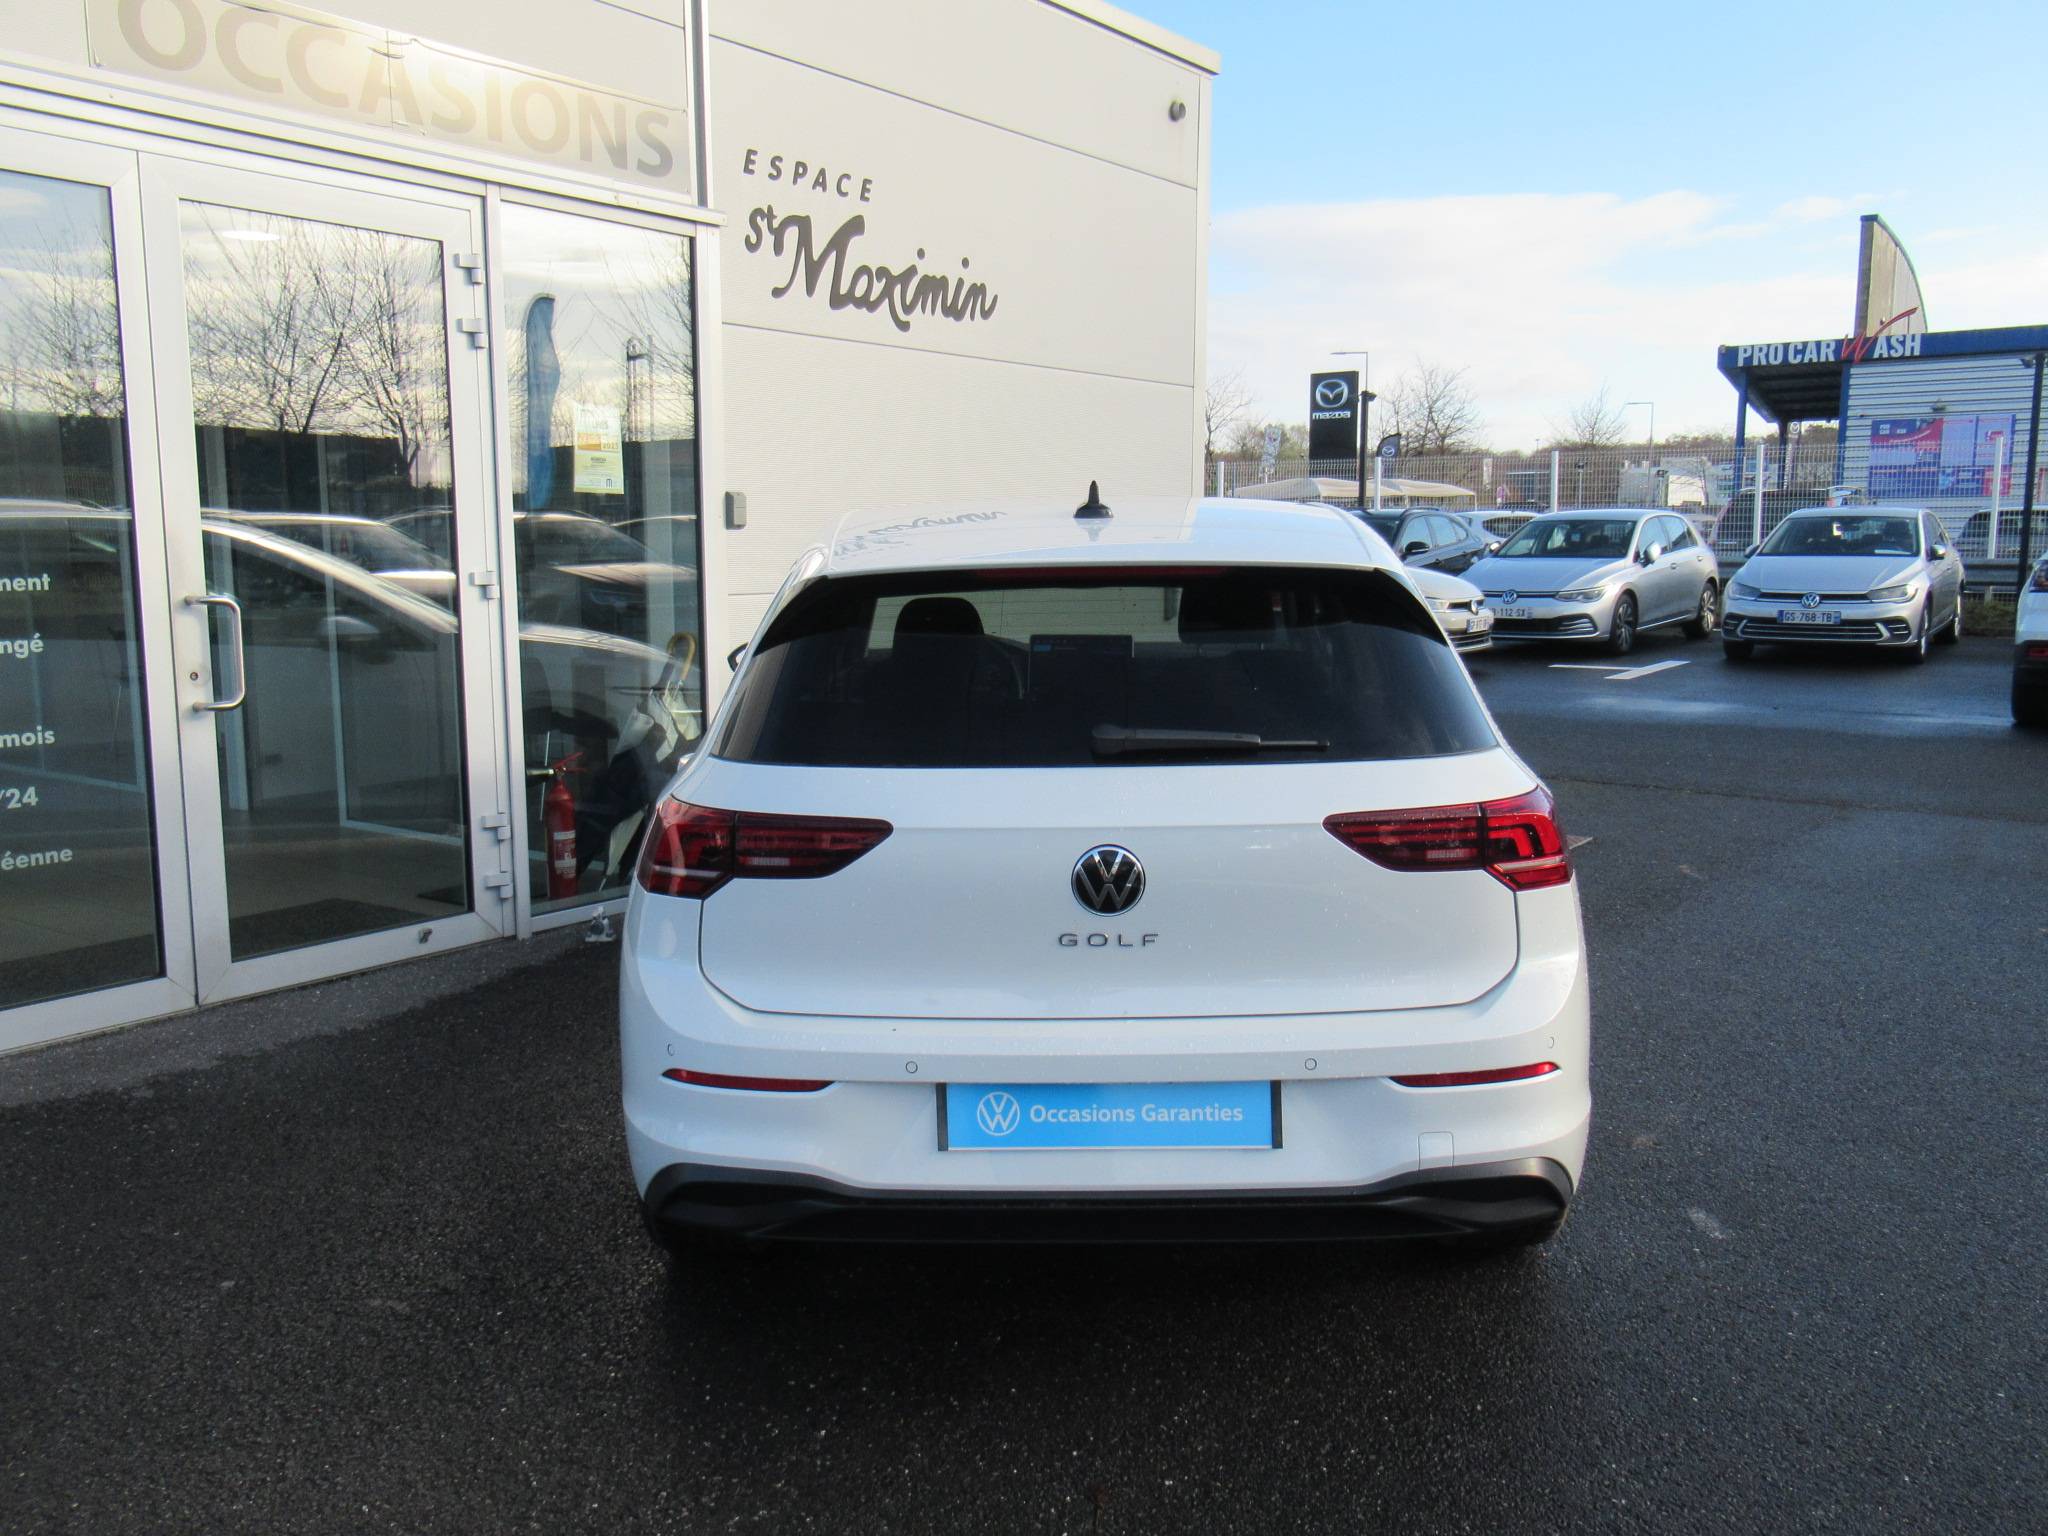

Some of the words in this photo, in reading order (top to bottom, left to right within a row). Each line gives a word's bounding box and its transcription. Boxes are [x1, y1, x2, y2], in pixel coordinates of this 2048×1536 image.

[118, 0, 674, 178] OCCASIONS
[743, 149, 873, 202] ESPACE
[771, 214, 998, 333] Maximin
[1737, 344, 1784, 367] PRO
[1788, 341, 1836, 364] CAR
[1312, 410, 1351, 420] mazda
[0, 725, 56, 748] mois
[1058, 932, 1159, 948] GOLF
[1029, 1104, 1135, 1123] Occasions
[1140, 1103, 1244, 1122] Garanties
